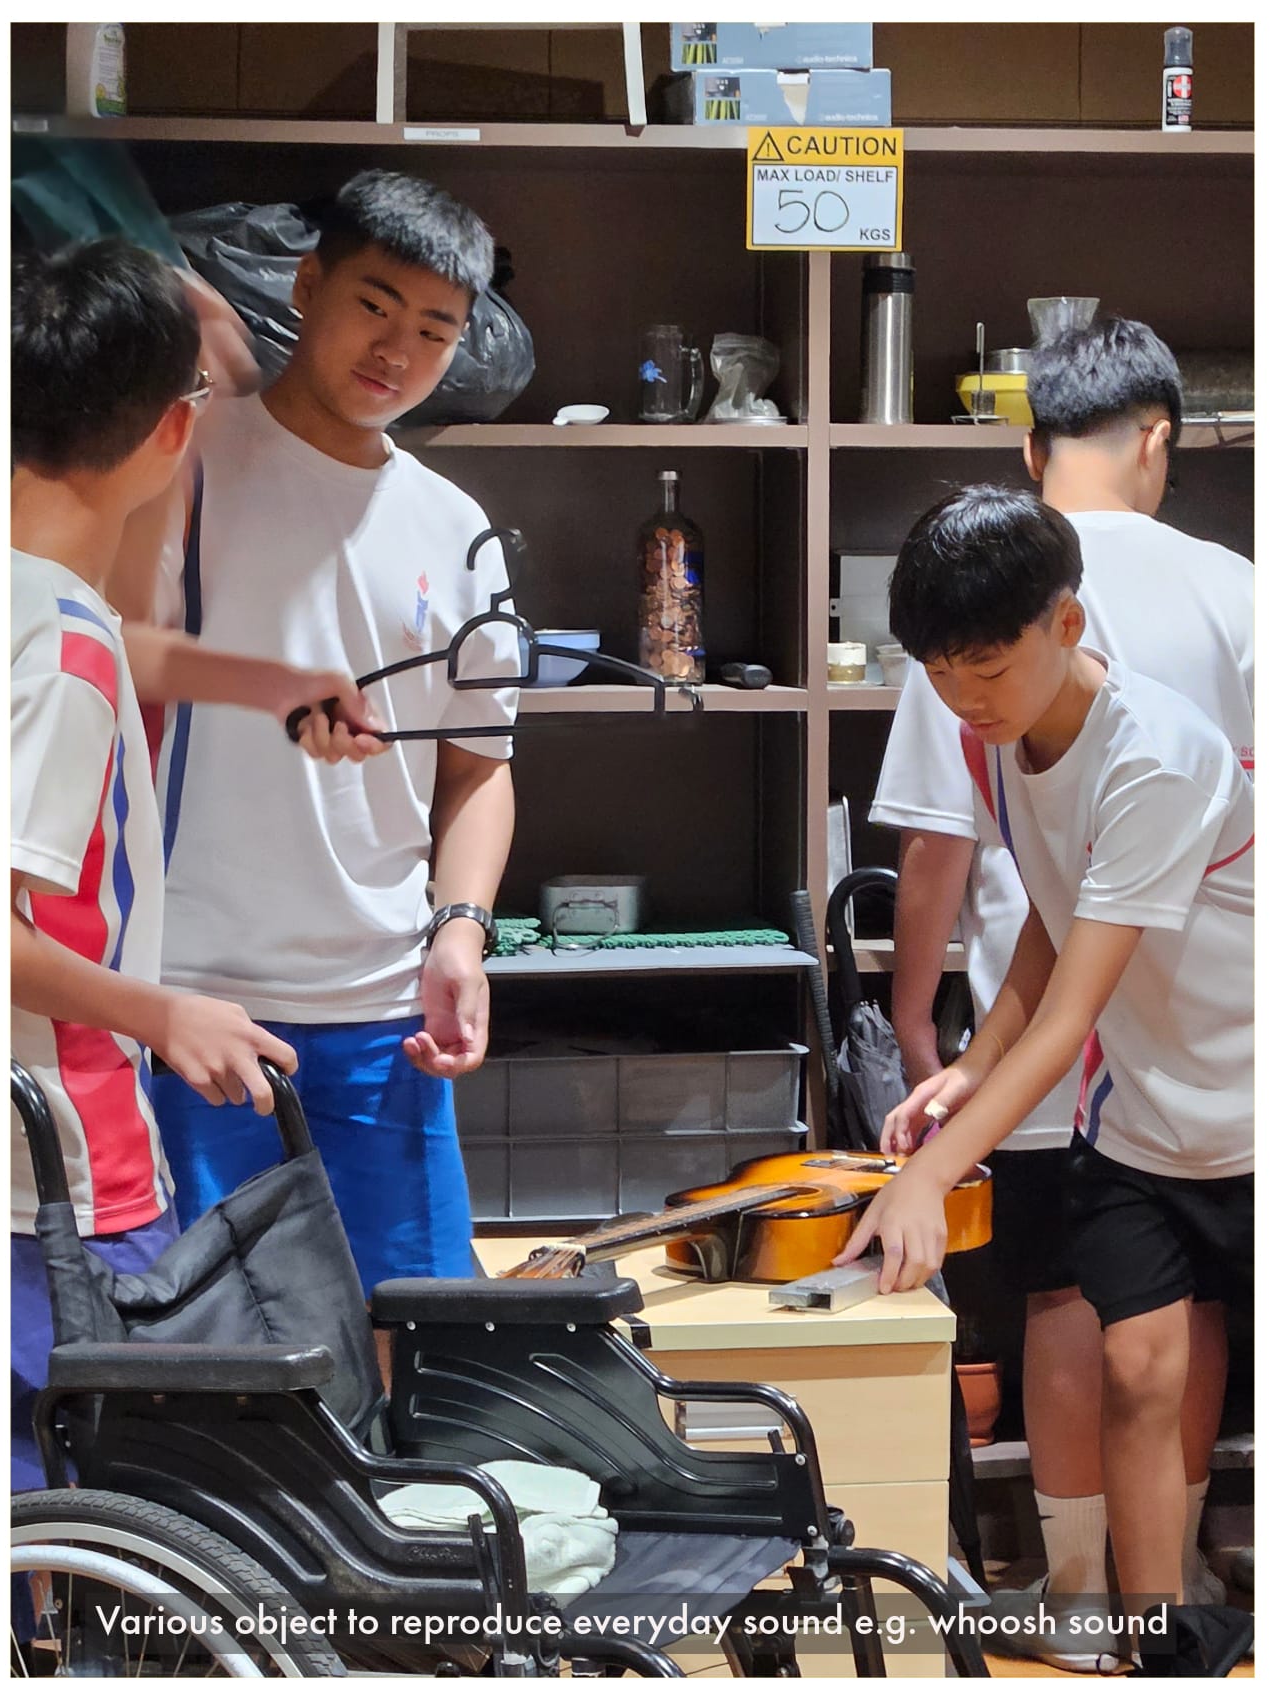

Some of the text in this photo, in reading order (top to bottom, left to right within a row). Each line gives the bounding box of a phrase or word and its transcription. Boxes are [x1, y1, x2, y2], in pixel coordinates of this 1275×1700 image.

[787, 135, 896, 156] CAUTION
[757, 169, 893, 183] MAX LOAD/ SHELF
[774, 189, 850, 234] 50
[860, 228, 891, 241] KGS
